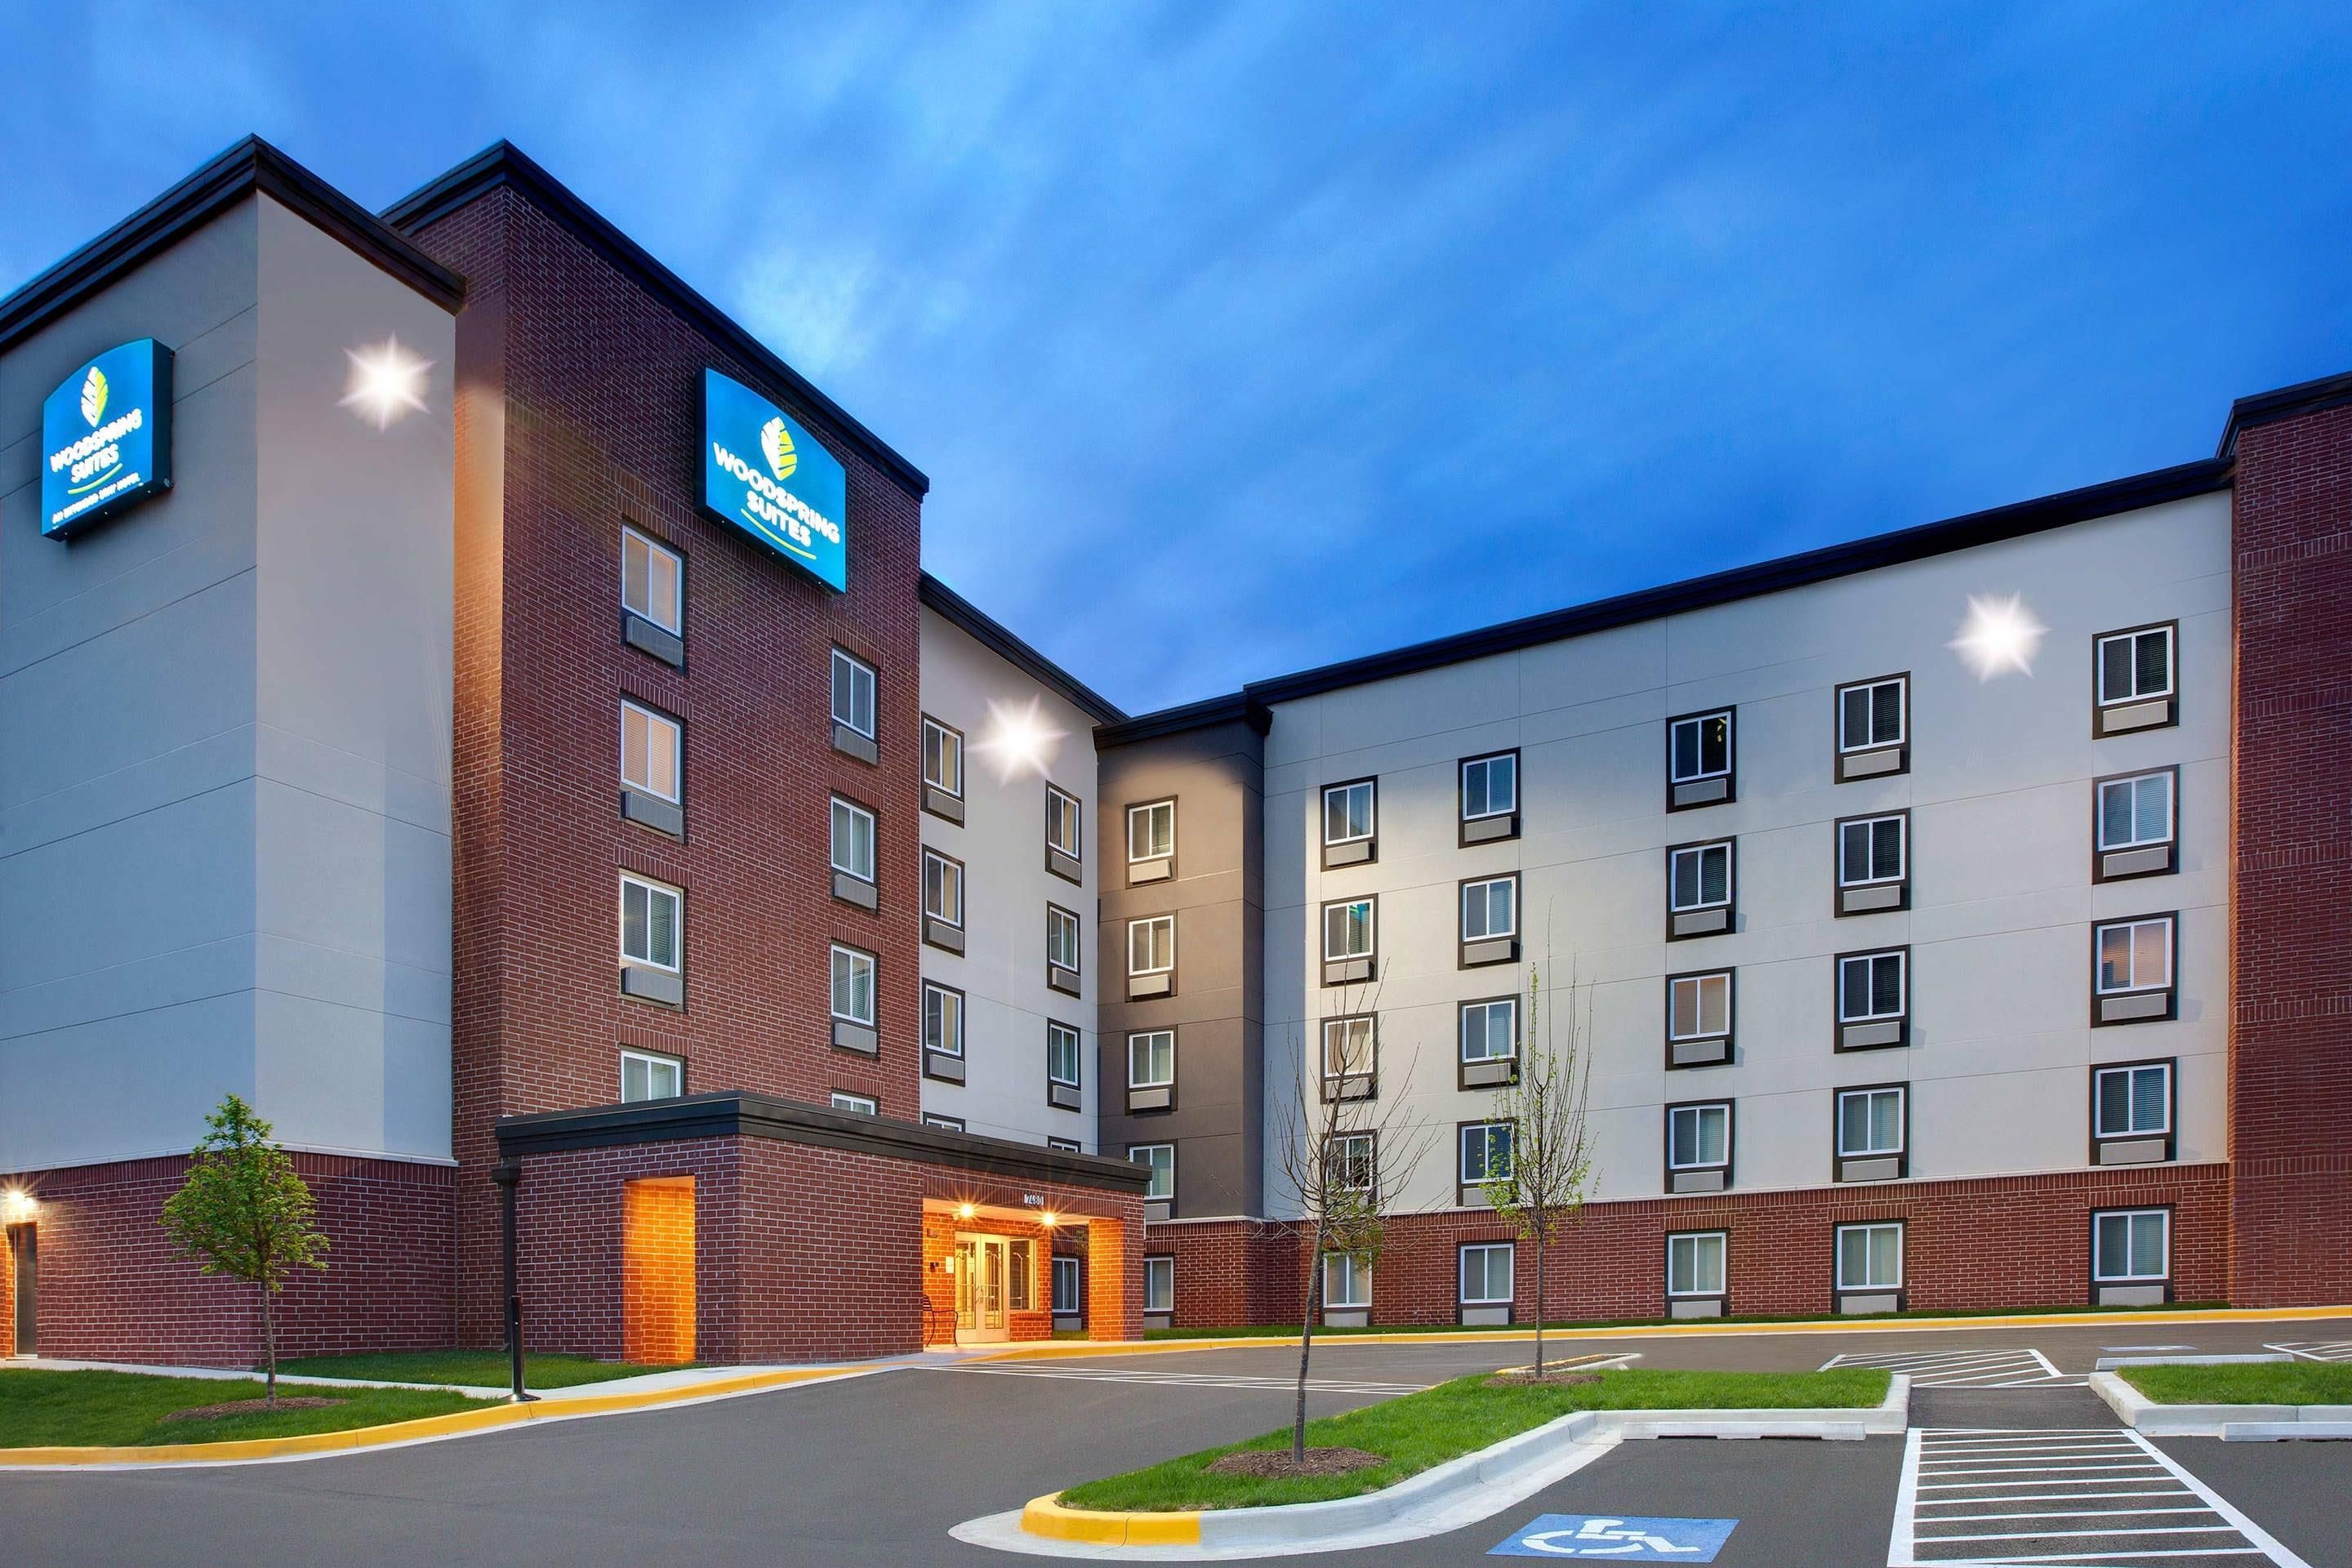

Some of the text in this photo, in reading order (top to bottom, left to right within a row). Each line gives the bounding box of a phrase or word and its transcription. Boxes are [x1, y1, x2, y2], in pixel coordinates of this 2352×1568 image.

[50, 408, 142, 472] WOODSPRING
[71, 443, 118, 483] SUITES
[713, 442, 840, 544] WOODSPRING
[746, 490, 812, 547] SUITES
